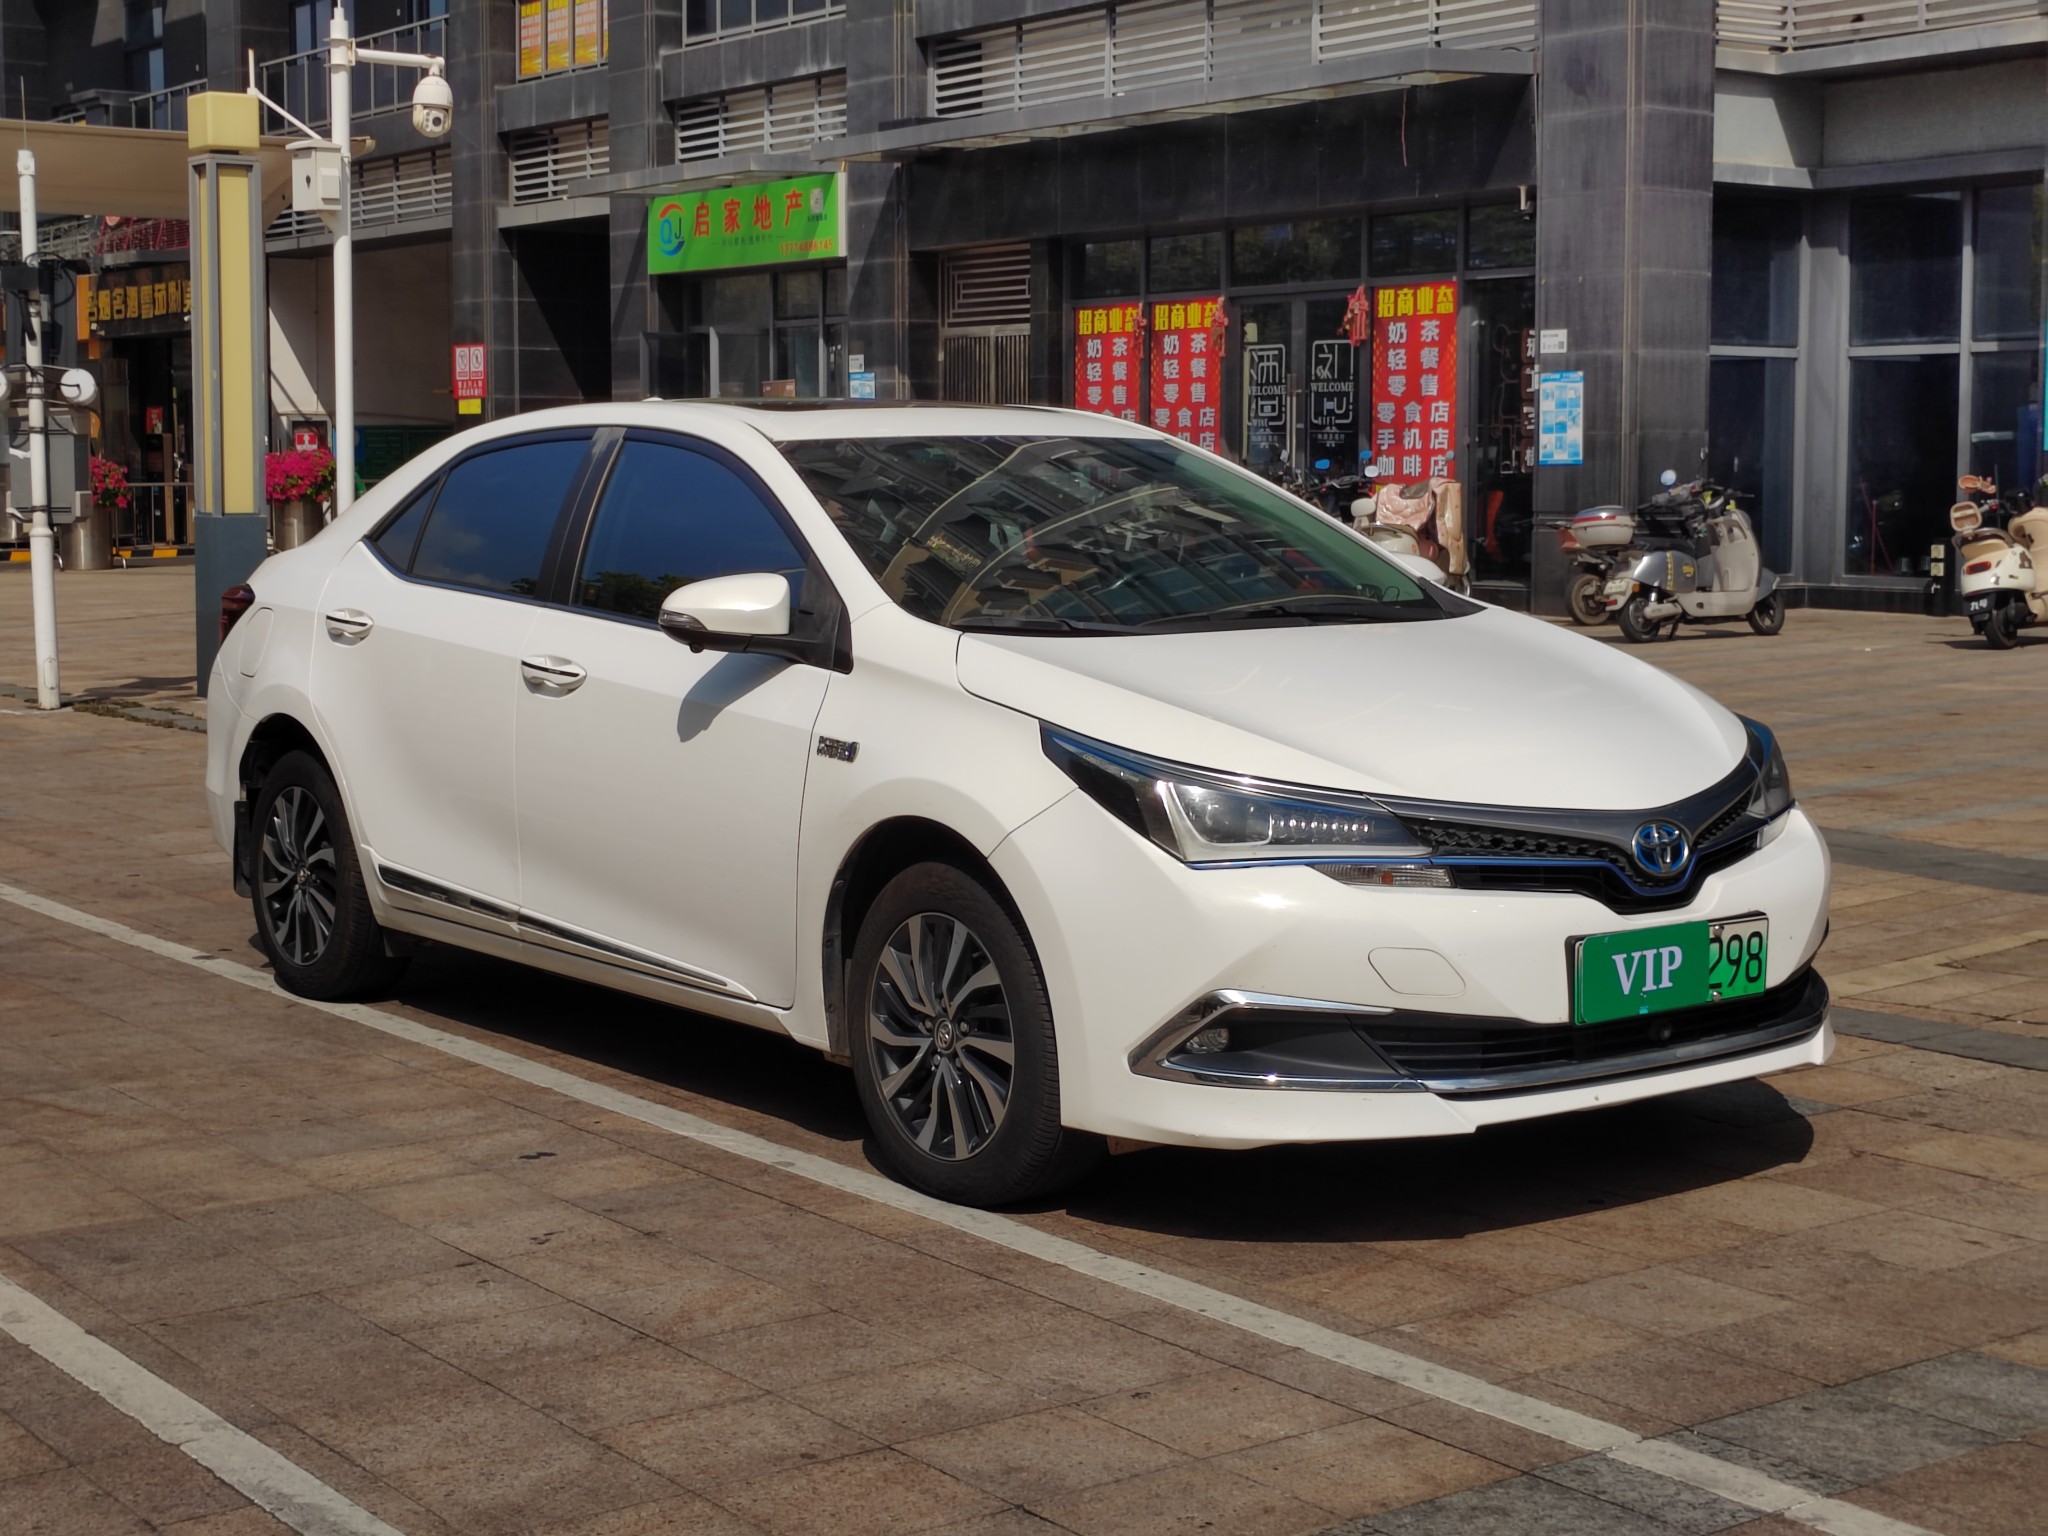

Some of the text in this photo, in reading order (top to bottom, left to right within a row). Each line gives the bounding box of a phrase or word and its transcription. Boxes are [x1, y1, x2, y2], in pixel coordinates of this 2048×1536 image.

[693, 189, 804, 237] 启家地产
[1378, 286, 1454, 318] 招商业态
[1388, 319, 1440, 344] 奶茶
[1087, 337, 1128, 358] 奶茶
[1163, 333, 1207, 355] 奶茶
[1163, 358, 1206, 379] 轻餐
[1388, 347, 1440, 371] 轻餐
[1086, 361, 1127, 382] 轻餐
[1087, 385, 1127, 405] 零售
[1163, 382, 1206, 403] 零售
[1248, 385, 1287, 396] ELCOME
[1310, 382, 1354, 393] WELCOME
[1388, 374, 1439, 397] 零售
[1154, 406, 1215, 428] 零食店
[1377, 401, 1450, 424] 零食店
[1377, 428, 1449, 450] 手机店
[1377, 454, 1449, 477] 咖啡店
[1611, 945, 1683, 995] VIP
[1708, 930, 1763, 990] 298
